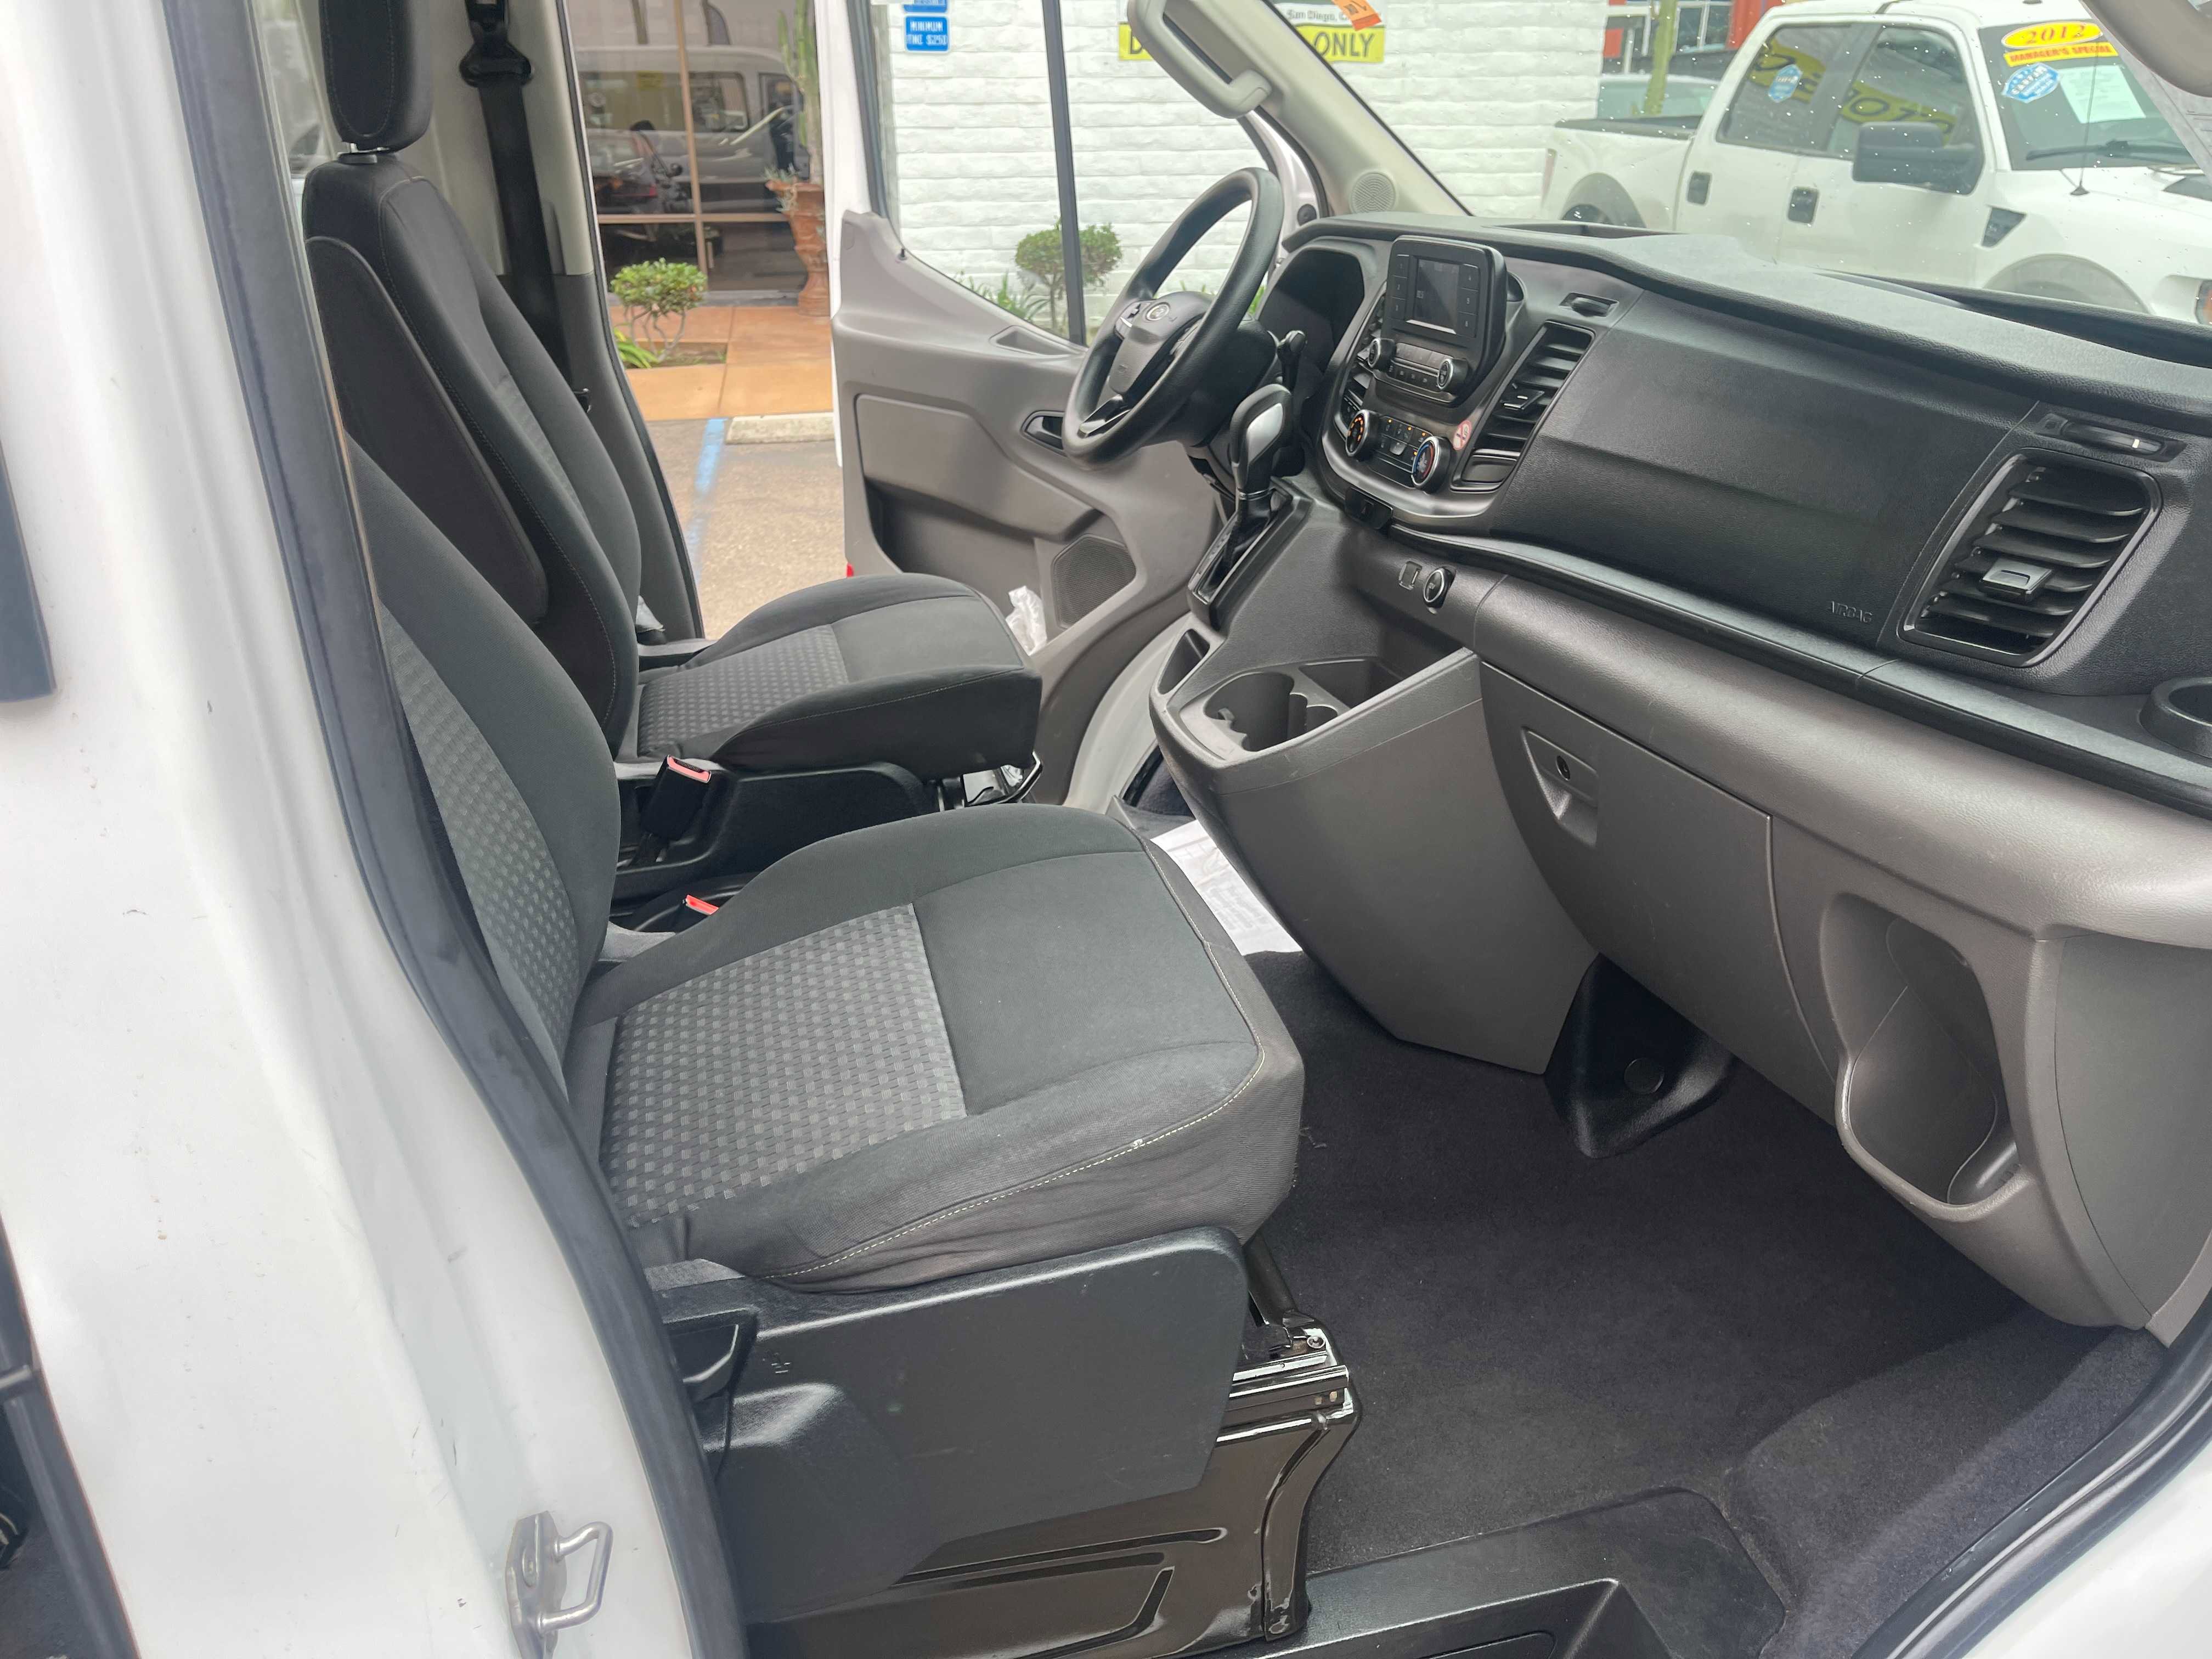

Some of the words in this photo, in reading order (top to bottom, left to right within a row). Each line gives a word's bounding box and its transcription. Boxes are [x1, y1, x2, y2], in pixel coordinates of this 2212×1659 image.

[1286, 9, 1306, 19] San
[910, 21, 943, 31] MINIMUM
[2026, 25, 2085, 44] 2012
[1314, 32, 1375, 57] ONLY
[2010, 47, 2069, 62] MANAGER'S
[2071, 45, 2111, 54] SPECIAL
[1830, 601, 1873, 623] AIRBAG
